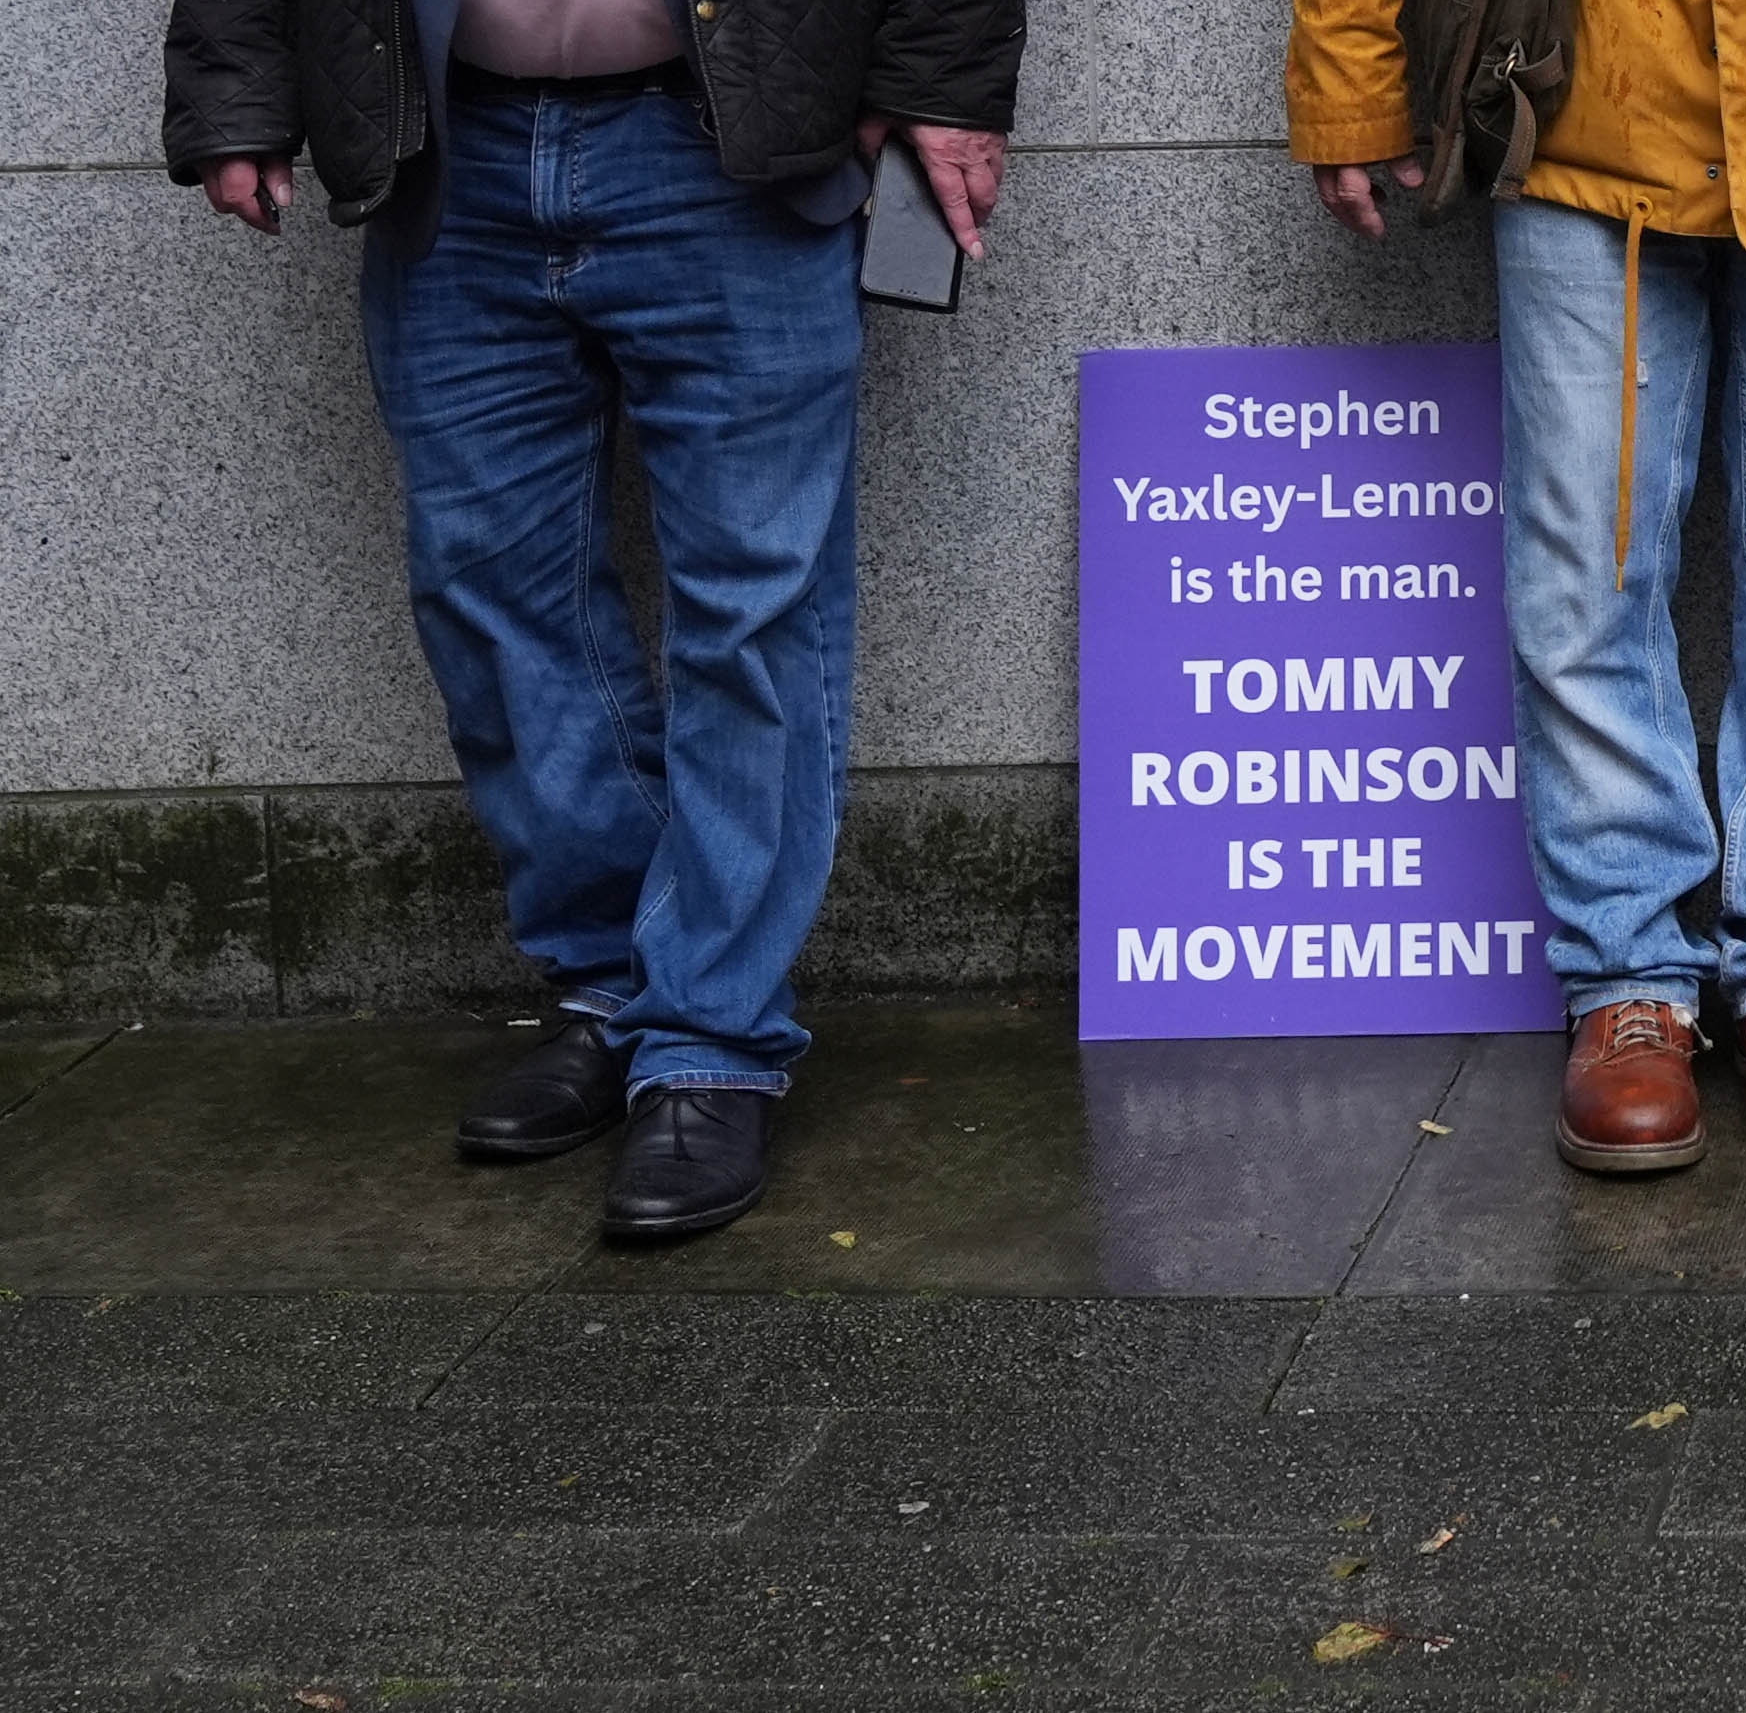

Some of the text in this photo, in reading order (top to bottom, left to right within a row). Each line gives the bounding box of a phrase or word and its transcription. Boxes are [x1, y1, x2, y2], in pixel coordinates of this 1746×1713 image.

[1205, 390, 1439, 449] Stephen
[1113, 474, 1503, 532] Yaxley-Lenno
[1171, 555, 1475, 603] is the man.
[1183, 656, 1464, 713] TOMMY
[1131, 746, 1516, 806] ROBINSON
[1229, 838, 1421, 889] IS THE
[1118, 921, 1534, 981] MOVEMENT
